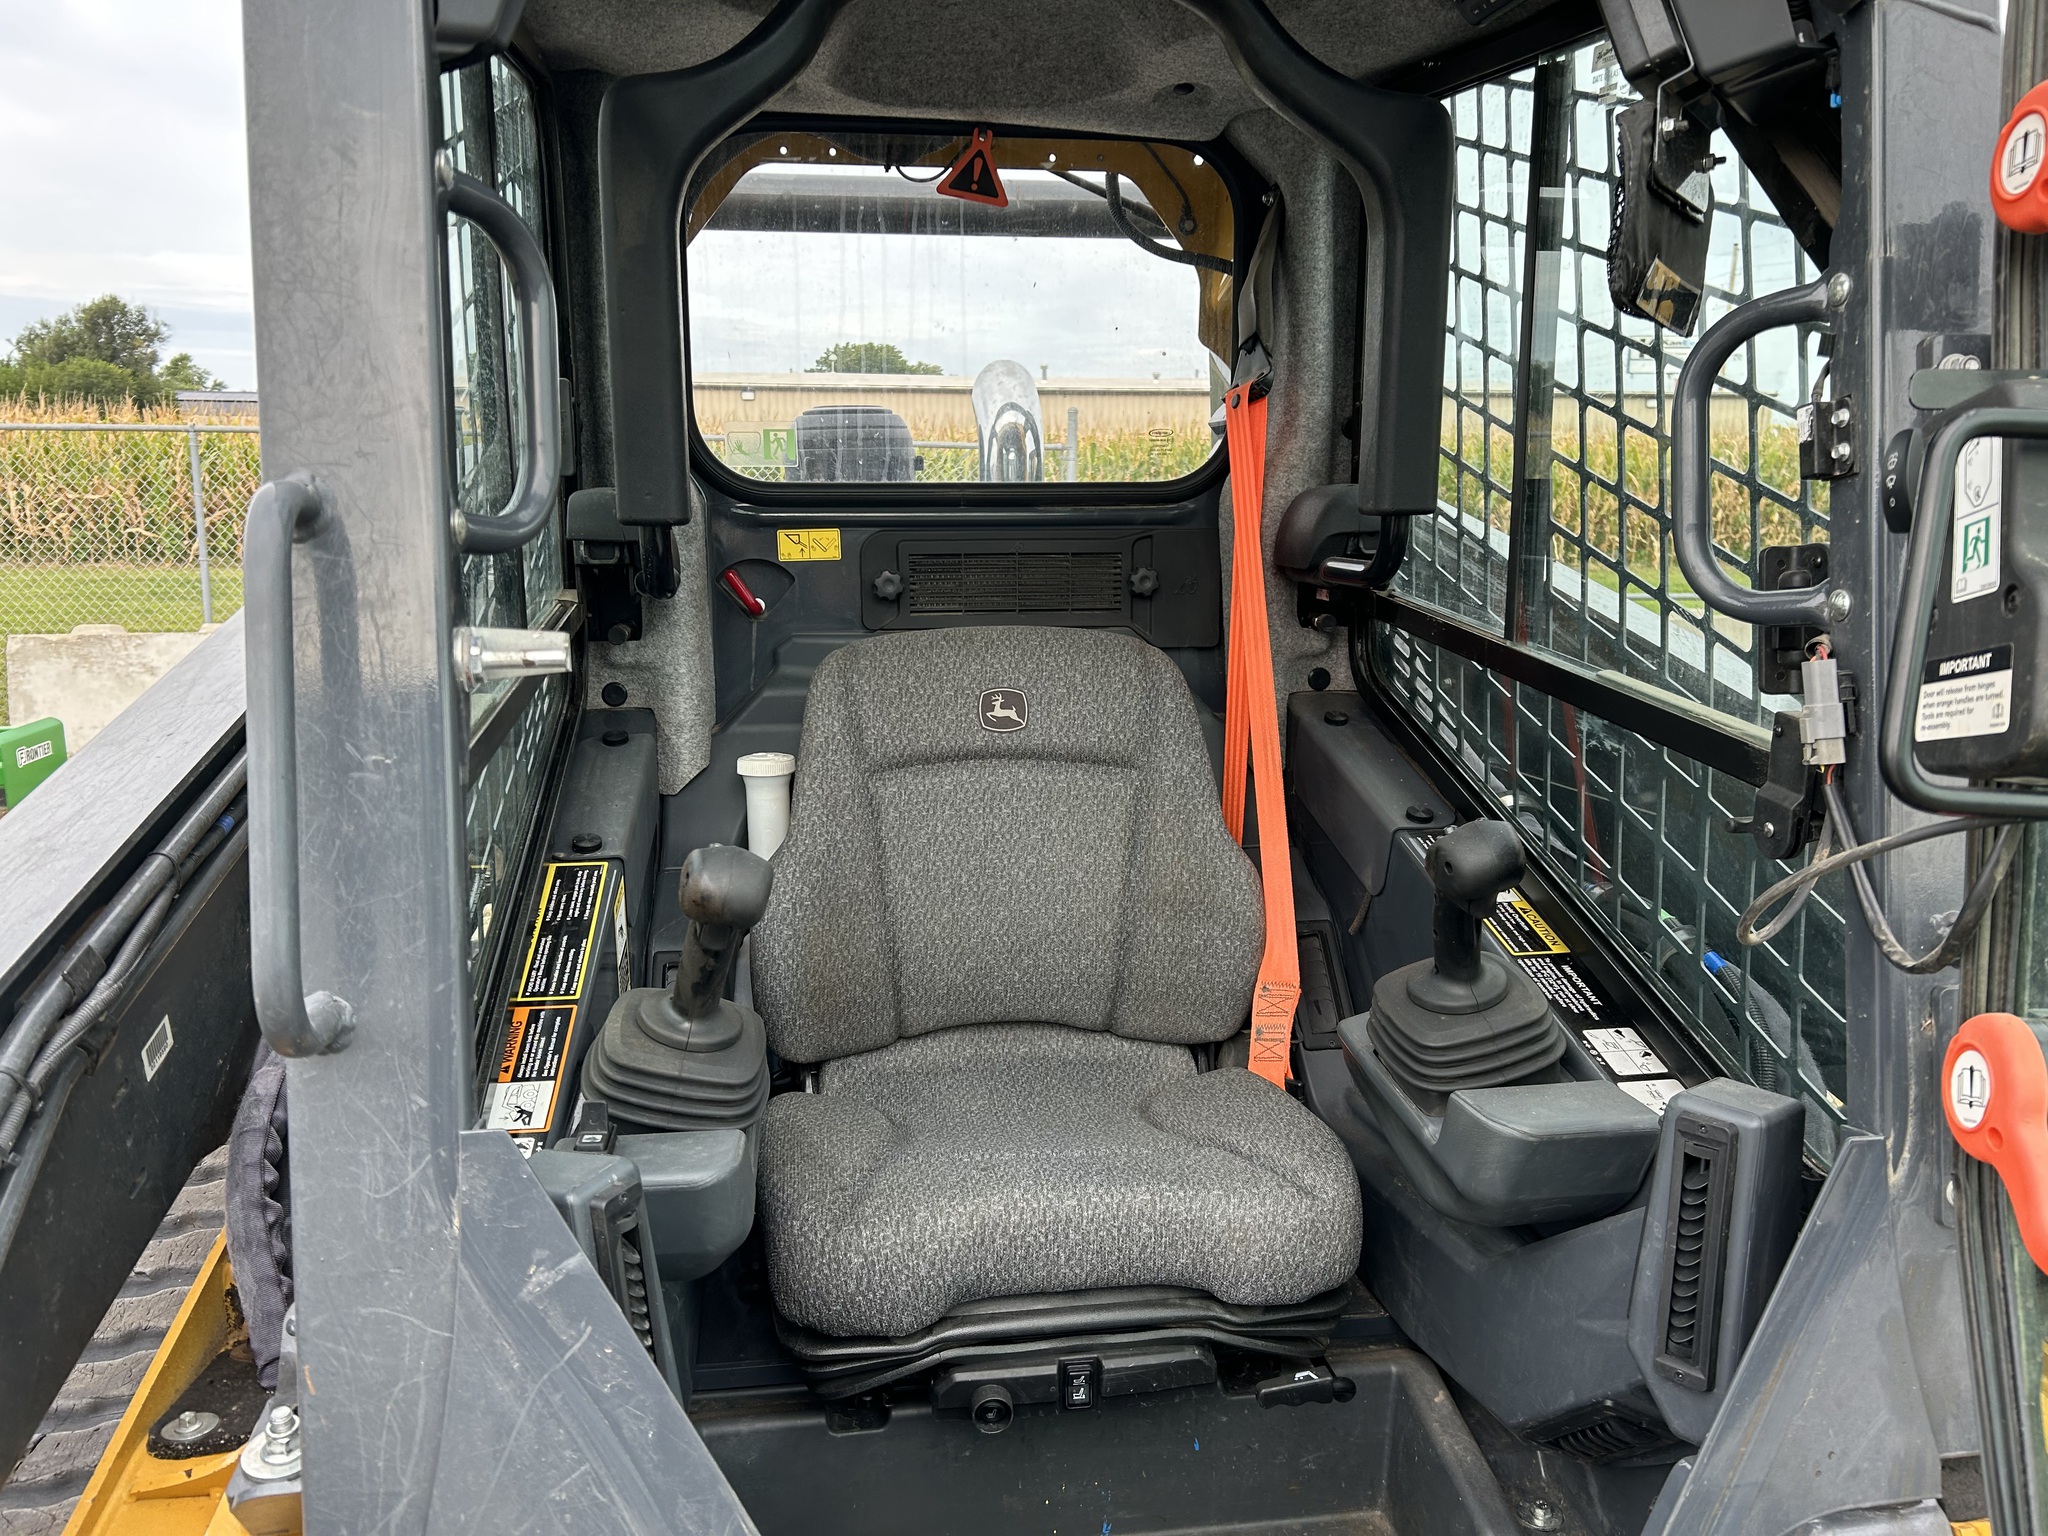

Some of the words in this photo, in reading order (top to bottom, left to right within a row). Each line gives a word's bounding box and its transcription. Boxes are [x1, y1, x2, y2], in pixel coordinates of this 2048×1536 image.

[1939, 652, 1992, 677] IMPORTANT
[1923, 691, 1935, 699] Door
[1946, 687, 1963, 695] release
[1978, 681, 1995, 690] hinges
[1937, 699, 1953, 709] orange
[1955, 696, 1974, 705] handles
[1985, 690, 2004, 700] turned.
[1922, 712, 1934, 720] Tools
[1945, 708, 1966, 717] required
[18, 742, 51, 766] FRONTIER
[1526, 913, 1561, 946] CAUTION
[533, 976, 541, 991] Operator's
[1523, 958, 1532, 966] idle
[1540, 978, 1554, 994] minutes
[1553, 994, 1567, 1008] before
[1530, 958, 1543, 970] below
[1558, 990, 1566, 998] run
[1561, 964, 1603, 1006] IMPORTANT
[1547, 963, 1564, 978] prevent
[1561, 978, 1577, 994] damage
[1578, 997, 1600, 1021] hydraulics
[1559, 984, 1585, 1011] temperatures
[502, 1020, 522, 1064] WARNING
[517, 1065, 525, 1077] Always
[544, 1051, 553, 1069] Operator's
